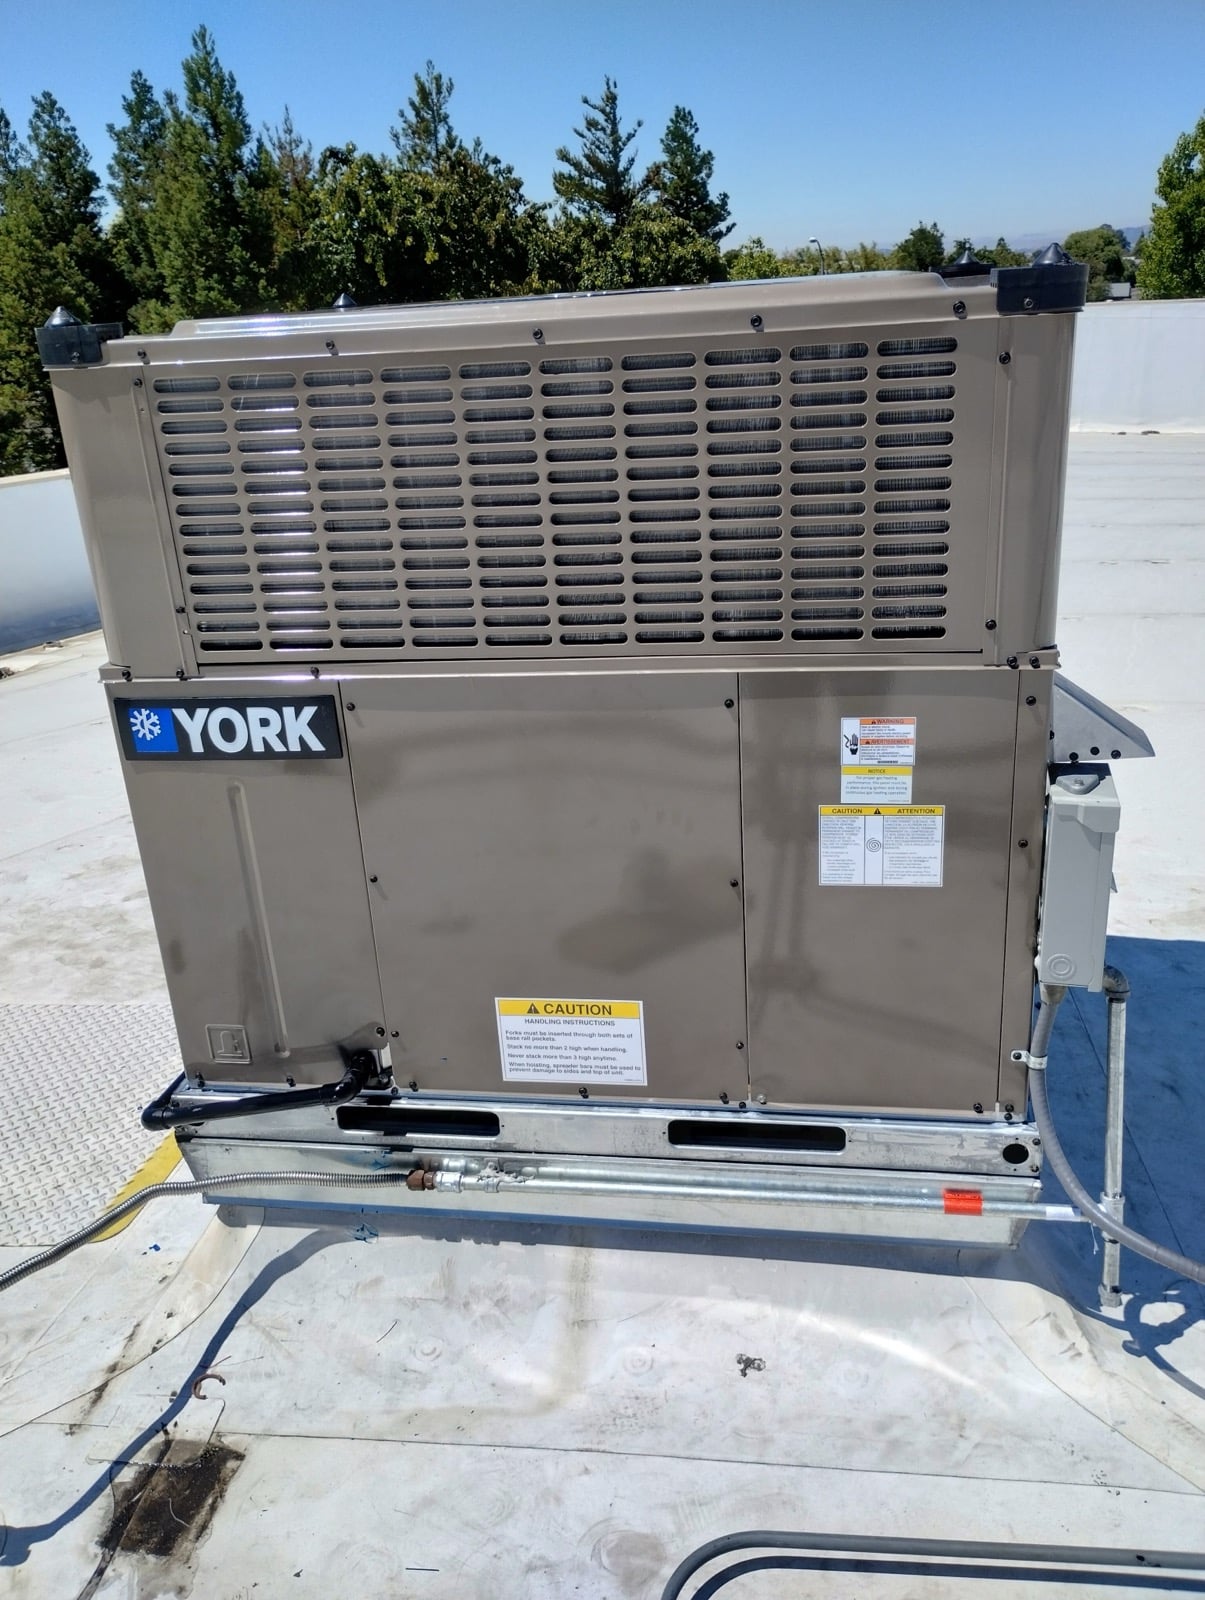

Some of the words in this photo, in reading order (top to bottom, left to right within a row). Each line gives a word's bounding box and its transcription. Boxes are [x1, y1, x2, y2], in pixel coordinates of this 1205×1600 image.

[171, 706, 326, 753] YORK
[543, 1003, 612, 1016] CAUTION
[563, 1019, 615, 1027] INSTRUCTIONS
